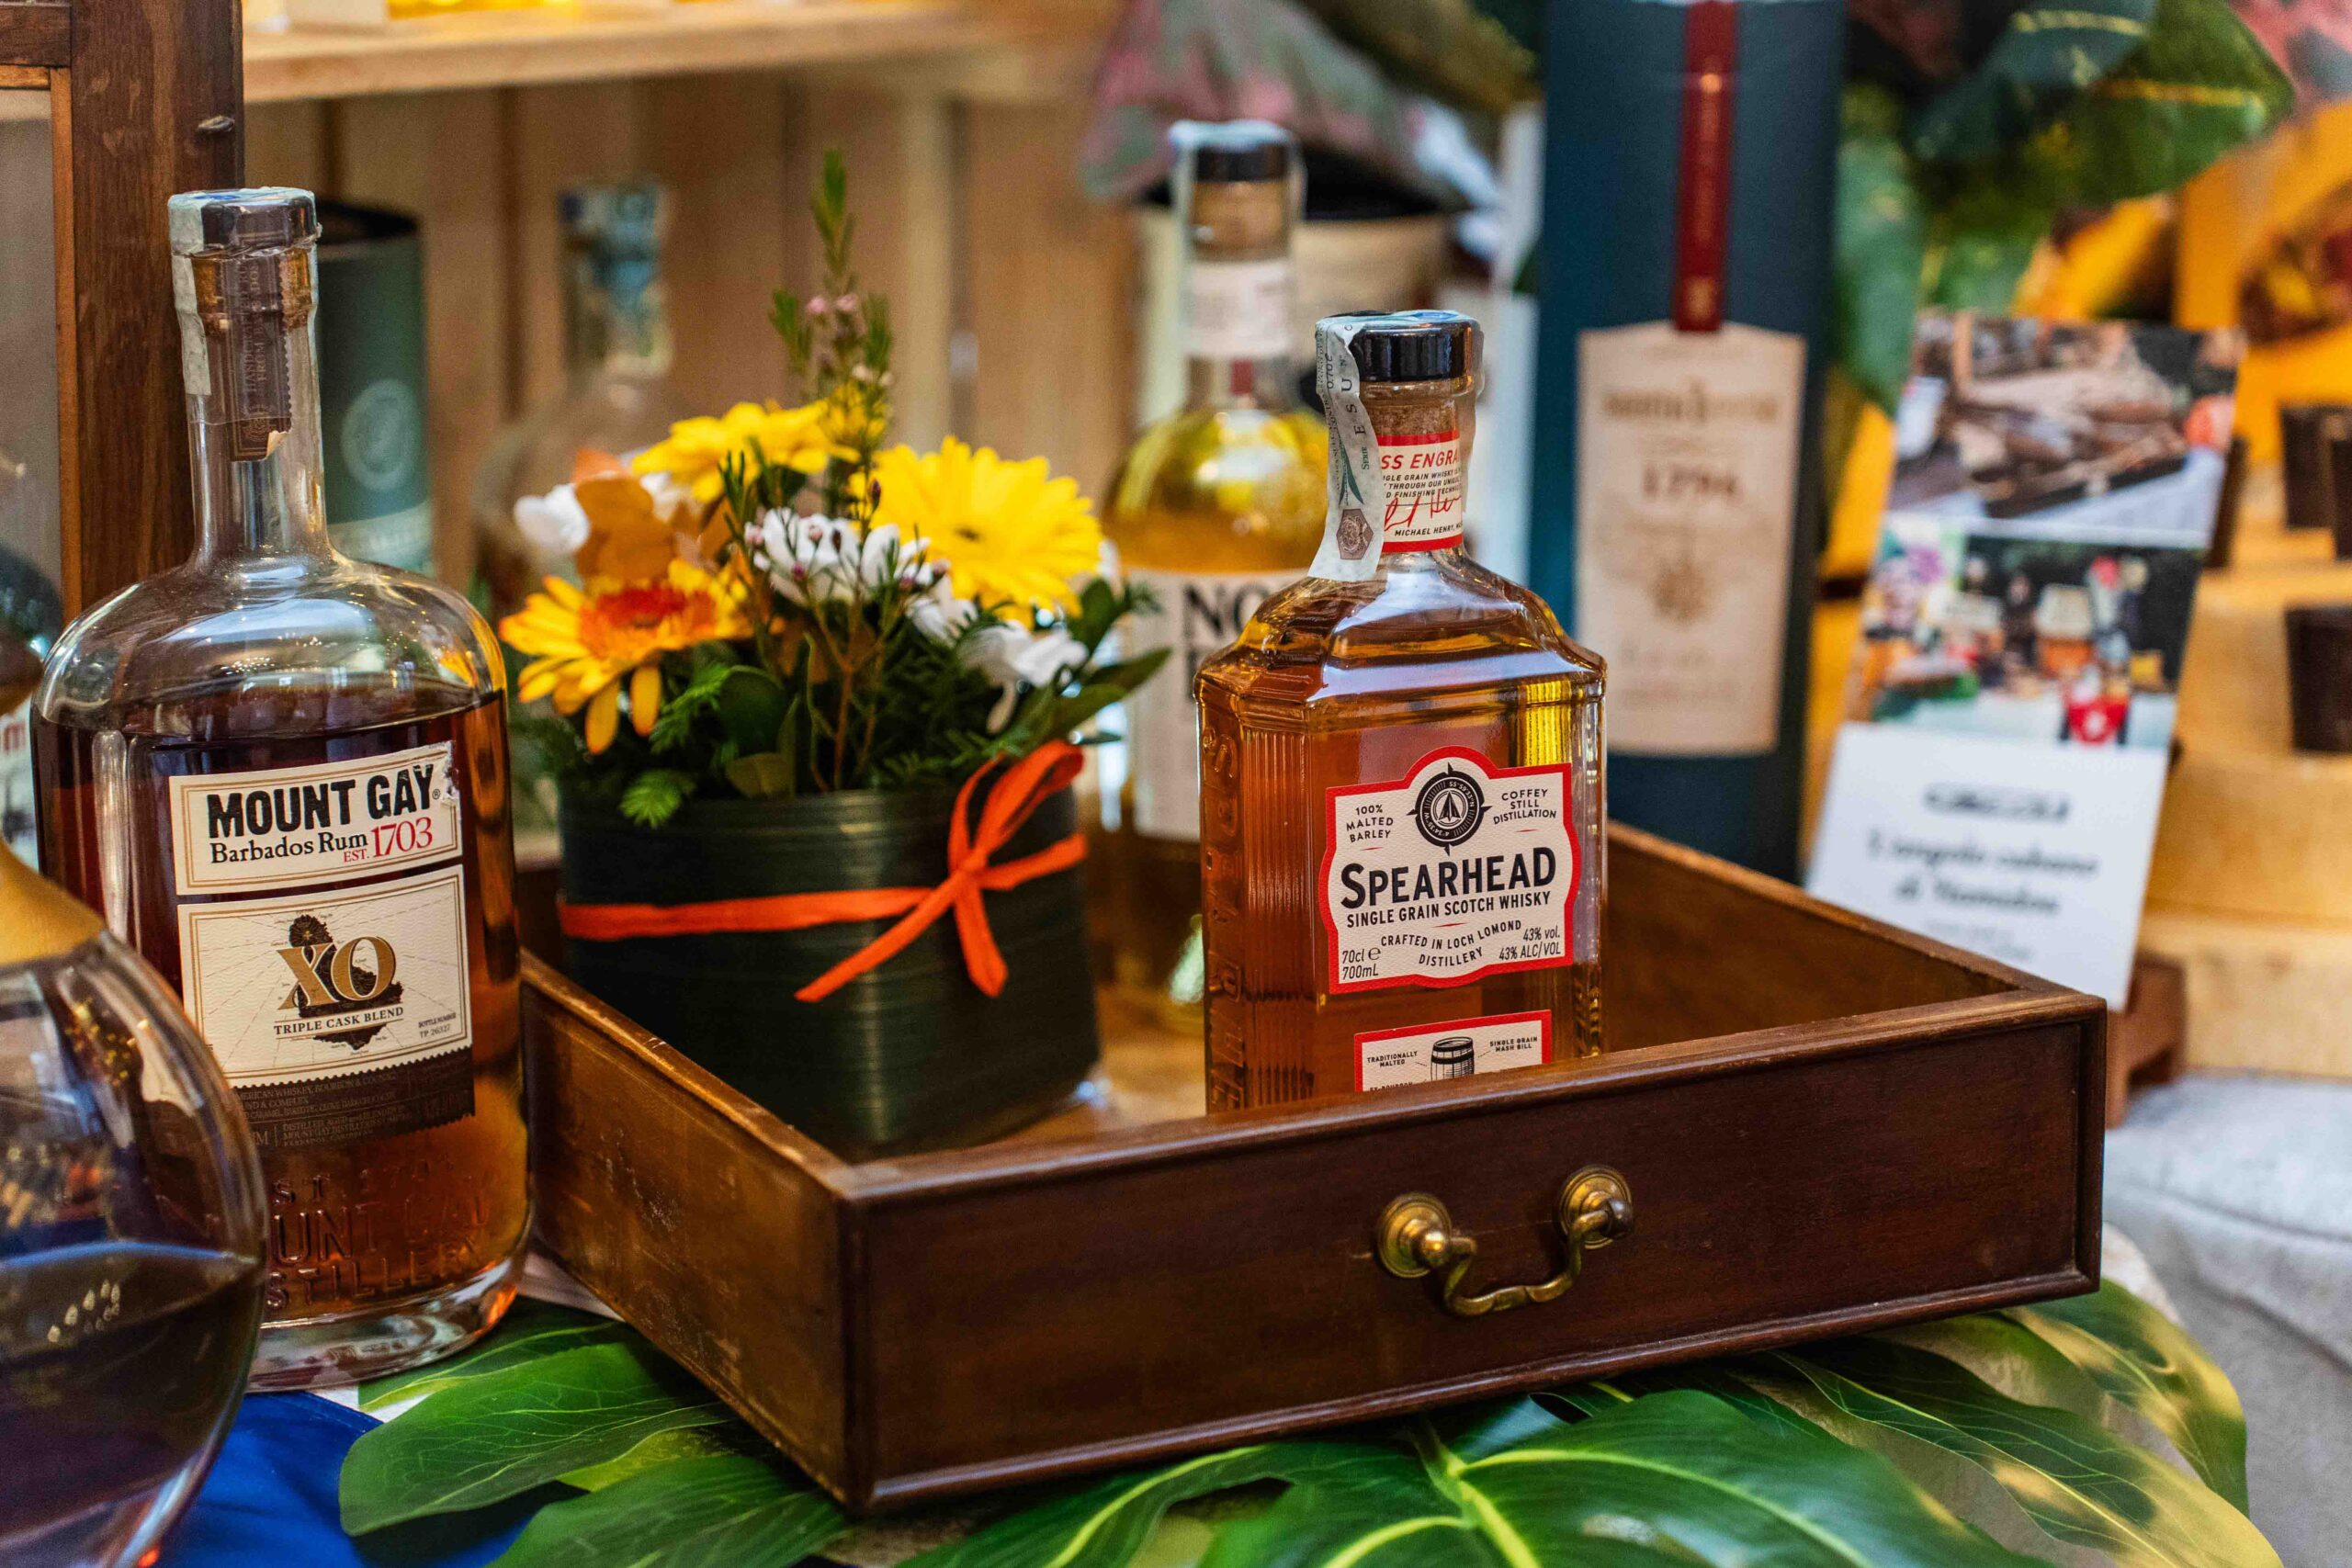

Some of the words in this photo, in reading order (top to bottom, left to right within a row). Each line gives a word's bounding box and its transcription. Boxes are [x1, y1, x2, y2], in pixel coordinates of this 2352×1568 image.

[247, 262, 264, 334] BABADOS
[1404, 473, 1429, 481] GRAIN
[1395, 489, 1435, 499] FINISHING
[1395, 527, 1430, 537] MICHAEL
[1433, 524, 1455, 534] HENRY,
[206, 779, 356, 839] MOUNT
[367, 763, 434, 820] GAY
[1501, 788, 1549, 801] COFFEY
[1355, 804, 1383, 816] 100%
[1510, 799, 1540, 809] STILL
[1346, 817, 1394, 831] MALTED
[1493, 809, 1556, 825] DISTILLATION
[343, 847, 370, 863] EST.
[370, 817, 434, 858] 1703
[1350, 829, 1391, 842] BARLEY
[209, 835, 314, 864] Barbados
[317, 831, 368, 854] Rum
[1340, 847, 1556, 909] SPEARHEAD
[1347, 908, 1395, 928] SINGLE
[1399, 903, 1440, 921] GRAIN
[1444, 897, 1495, 916] SCOTCH
[1499, 890, 1551, 909] WHISKY
[1381, 934, 1428, 947] CRAFTED
[1431, 939, 1442, 950] IN
[1447, 934, 1475, 949] LOCH
[1477, 919, 1521, 940] LOMOND
[1523, 927, 1542, 942] 43%
[1544, 925, 1560, 938] vol.
[1342, 948, 1365, 964] 70cl
[1419, 946, 1483, 966] DISTILLERY
[1498, 945, 1518, 960] 43%
[1520, 941, 1561, 958] ALC/VOL
[276, 936, 397, 1010] XO
[1342, 963, 1379, 980] 700mL
[274, 1021, 322, 1036] TRIPLE
[326, 1014, 361, 1030] CASK
[364, 1006, 404, 1022] BLEND
[1489, 1038, 1515, 1048] SINGLE
[1516, 1036, 1538, 1045] GRAIN
[1495, 1044, 1515, 1053] MASH
[1517, 1043, 1532, 1051] BILL
[1366, 1050, 1419, 1064] TRADITIONALLY
[1379, 1059, 1406, 1068] MALTED
